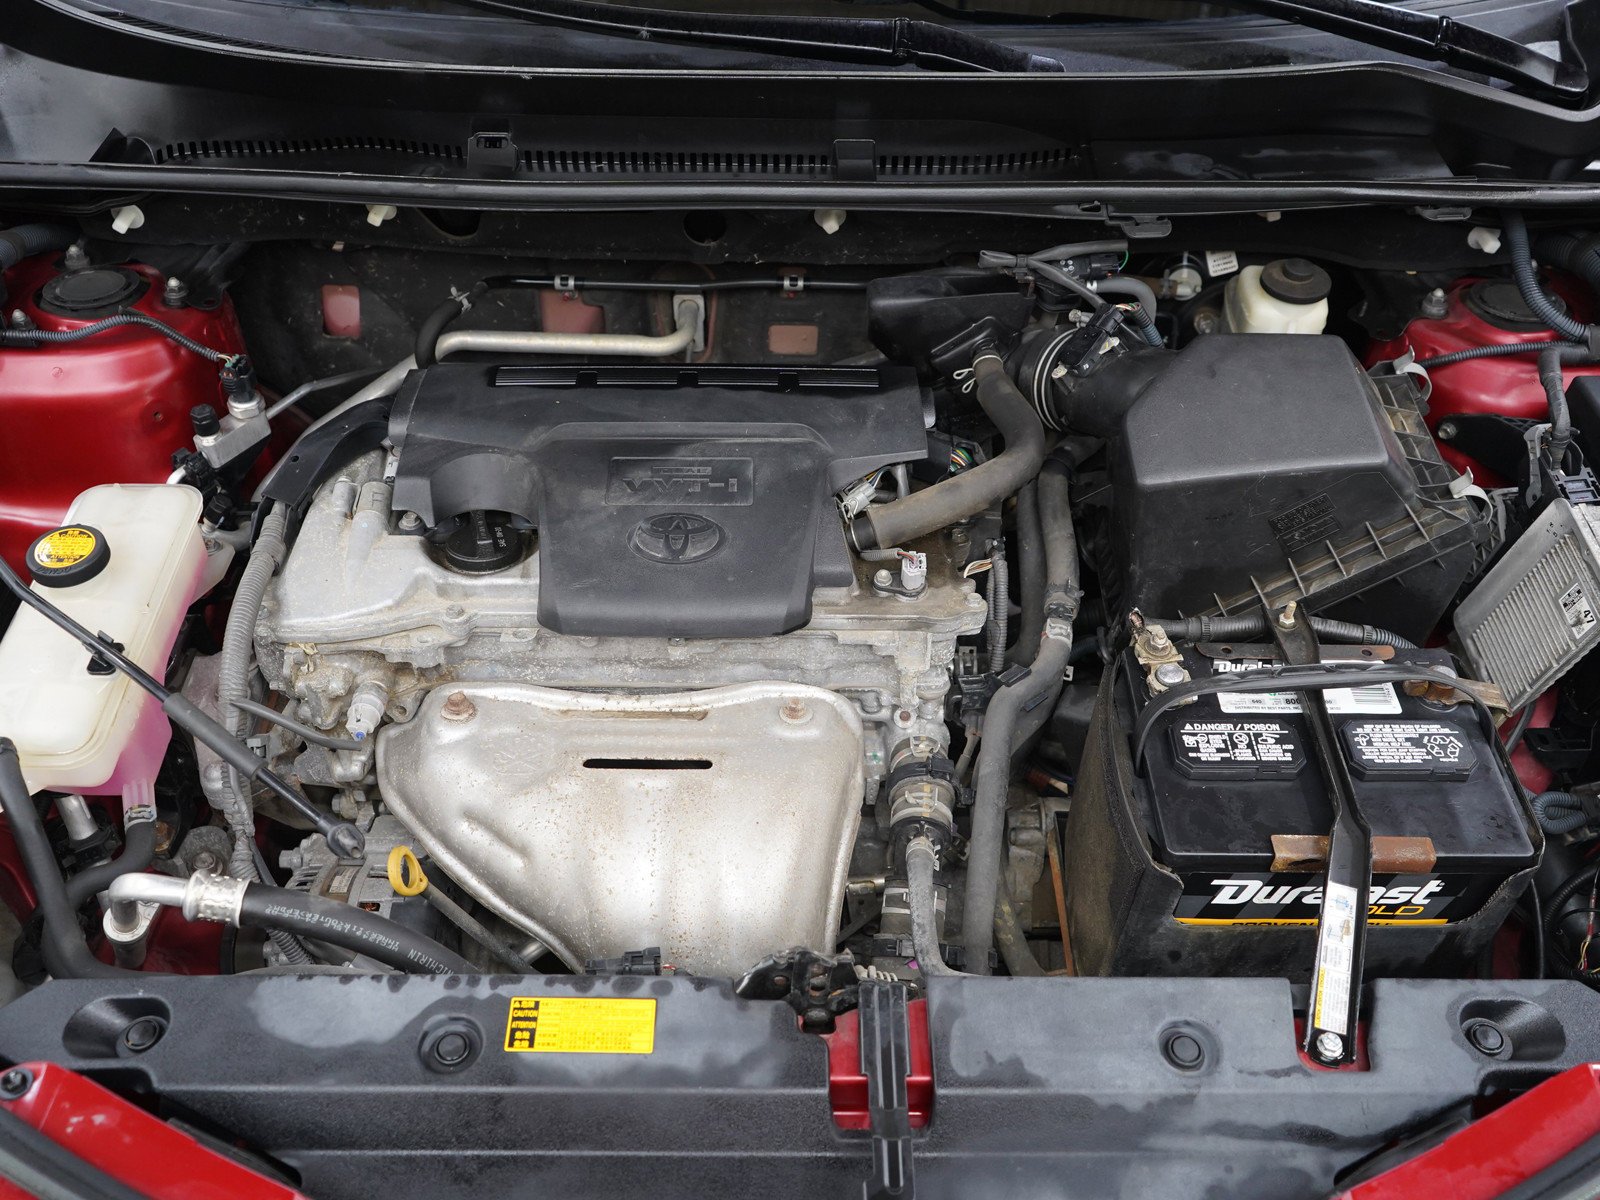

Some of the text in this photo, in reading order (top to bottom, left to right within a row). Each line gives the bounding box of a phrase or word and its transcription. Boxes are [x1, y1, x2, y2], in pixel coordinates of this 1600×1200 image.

[1583, 610, 1595, 624] 47
[1193, 723, 1234, 731] DANGER
[512, 1009, 539, 1017] CAUTION
